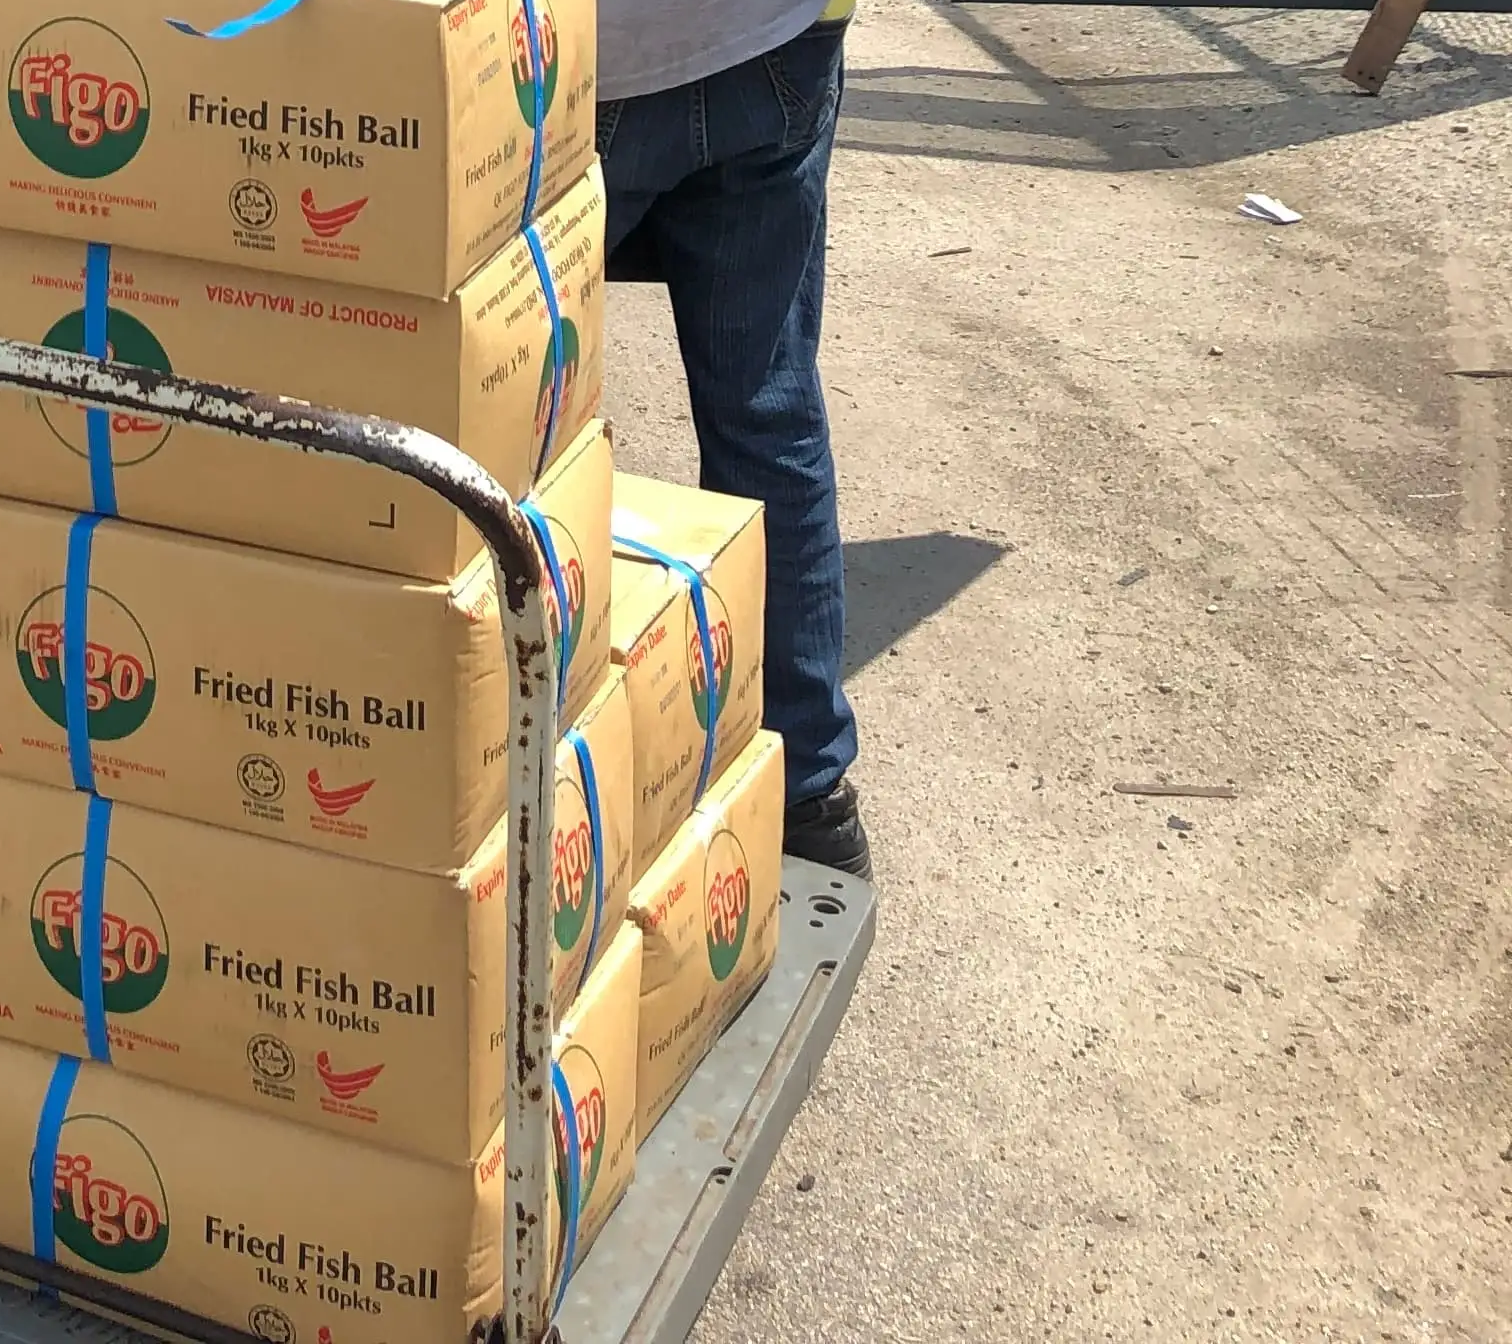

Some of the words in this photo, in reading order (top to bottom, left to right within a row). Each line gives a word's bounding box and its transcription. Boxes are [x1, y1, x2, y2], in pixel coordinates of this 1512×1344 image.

[510, 5, 557, 86] Fio
[19, 53, 141, 148] Figo
[189, 93, 268, 131] Fried
[281, 106, 344, 141] Fish
[357, 113, 420, 150] Ball
[239, 136, 272, 163] 1kg
[277, 141, 291, 160] X
[299, 144, 365, 169] 10pkts
[465, 158, 486, 189] Fried
[486, 148, 502, 174] Fish
[9, 179, 47, 194] MAKING
[48, 186, 96, 202] DELICIOUS
[98, 191, 157, 210] CONVENIENT
[31, 274, 84, 292] ONVENIENT
[142, 291, 180, 307] MAKING
[205, 284, 294, 313] MALAYSIA
[299, 300, 324, 318] OF
[328, 304, 418, 333] PRODUCT
[517, 342, 531, 365] 1kg
[480, 365, 509, 395] 10pkts
[194, 665, 273, 709] Fried
[286, 682, 349, 721] Fish
[363, 695, 425, 731] Ball
[21, 737, 59, 752] MAKING
[245, 712, 278, 738] 1kg
[284, 718, 297, 738] X
[305, 723, 371, 749] 10pkts
[708, 865, 749, 947] Figo
[204, 942, 283, 990] Fried
[296, 965, 359, 1005] Fish
[372, 979, 435, 1017] Ball
[254, 992, 288, 1018] 1kg
[293, 1000, 306, 1021] X
[314, 1006, 381, 1034] 10pkts
[489, 1024, 506, 1053] Fri
[648, 1031, 673, 1062] Fried
[204, 1214, 286, 1266] Fried
[298, 1241, 361, 1285] Fish
[374, 1260, 438, 1300] Ball
[255, 1265, 289, 1293] 1kg
[293, 1275, 308, 1295] X
[316, 1281, 382, 1315] 10pkts
